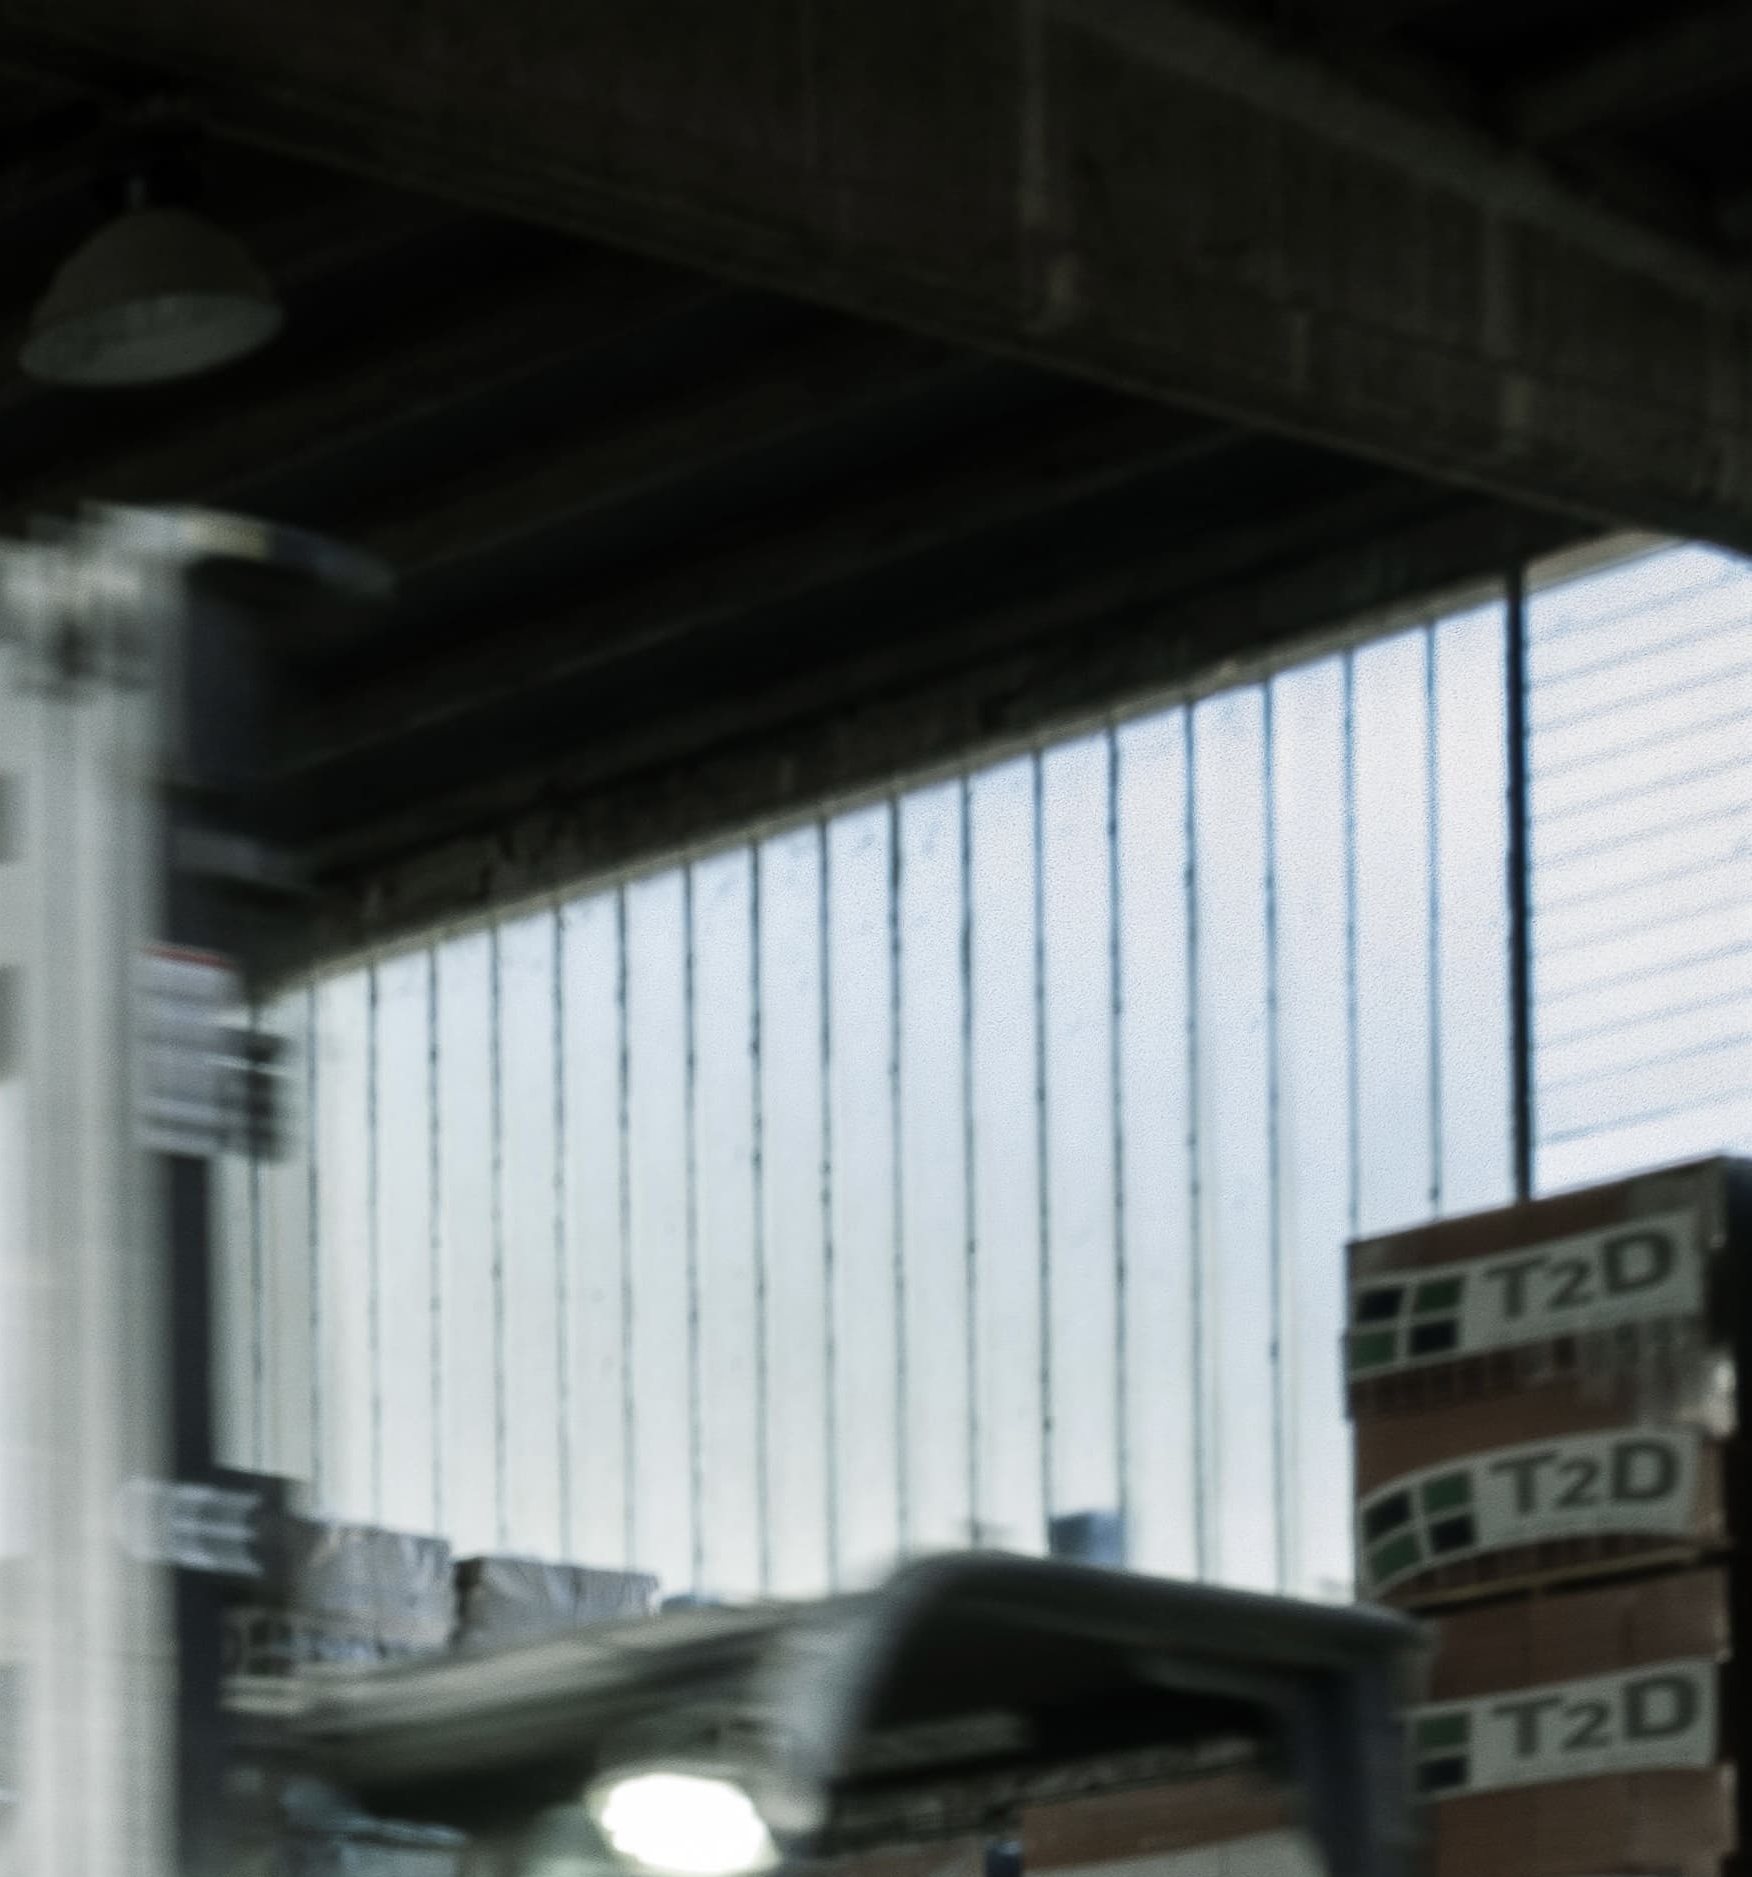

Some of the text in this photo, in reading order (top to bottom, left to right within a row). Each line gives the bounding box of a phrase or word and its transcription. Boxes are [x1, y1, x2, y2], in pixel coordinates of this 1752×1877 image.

[1484, 1228, 1677, 1318] T2D
[1490, 1437, 1683, 1516] T2D
[1493, 1672, 1699, 1759] T2D
